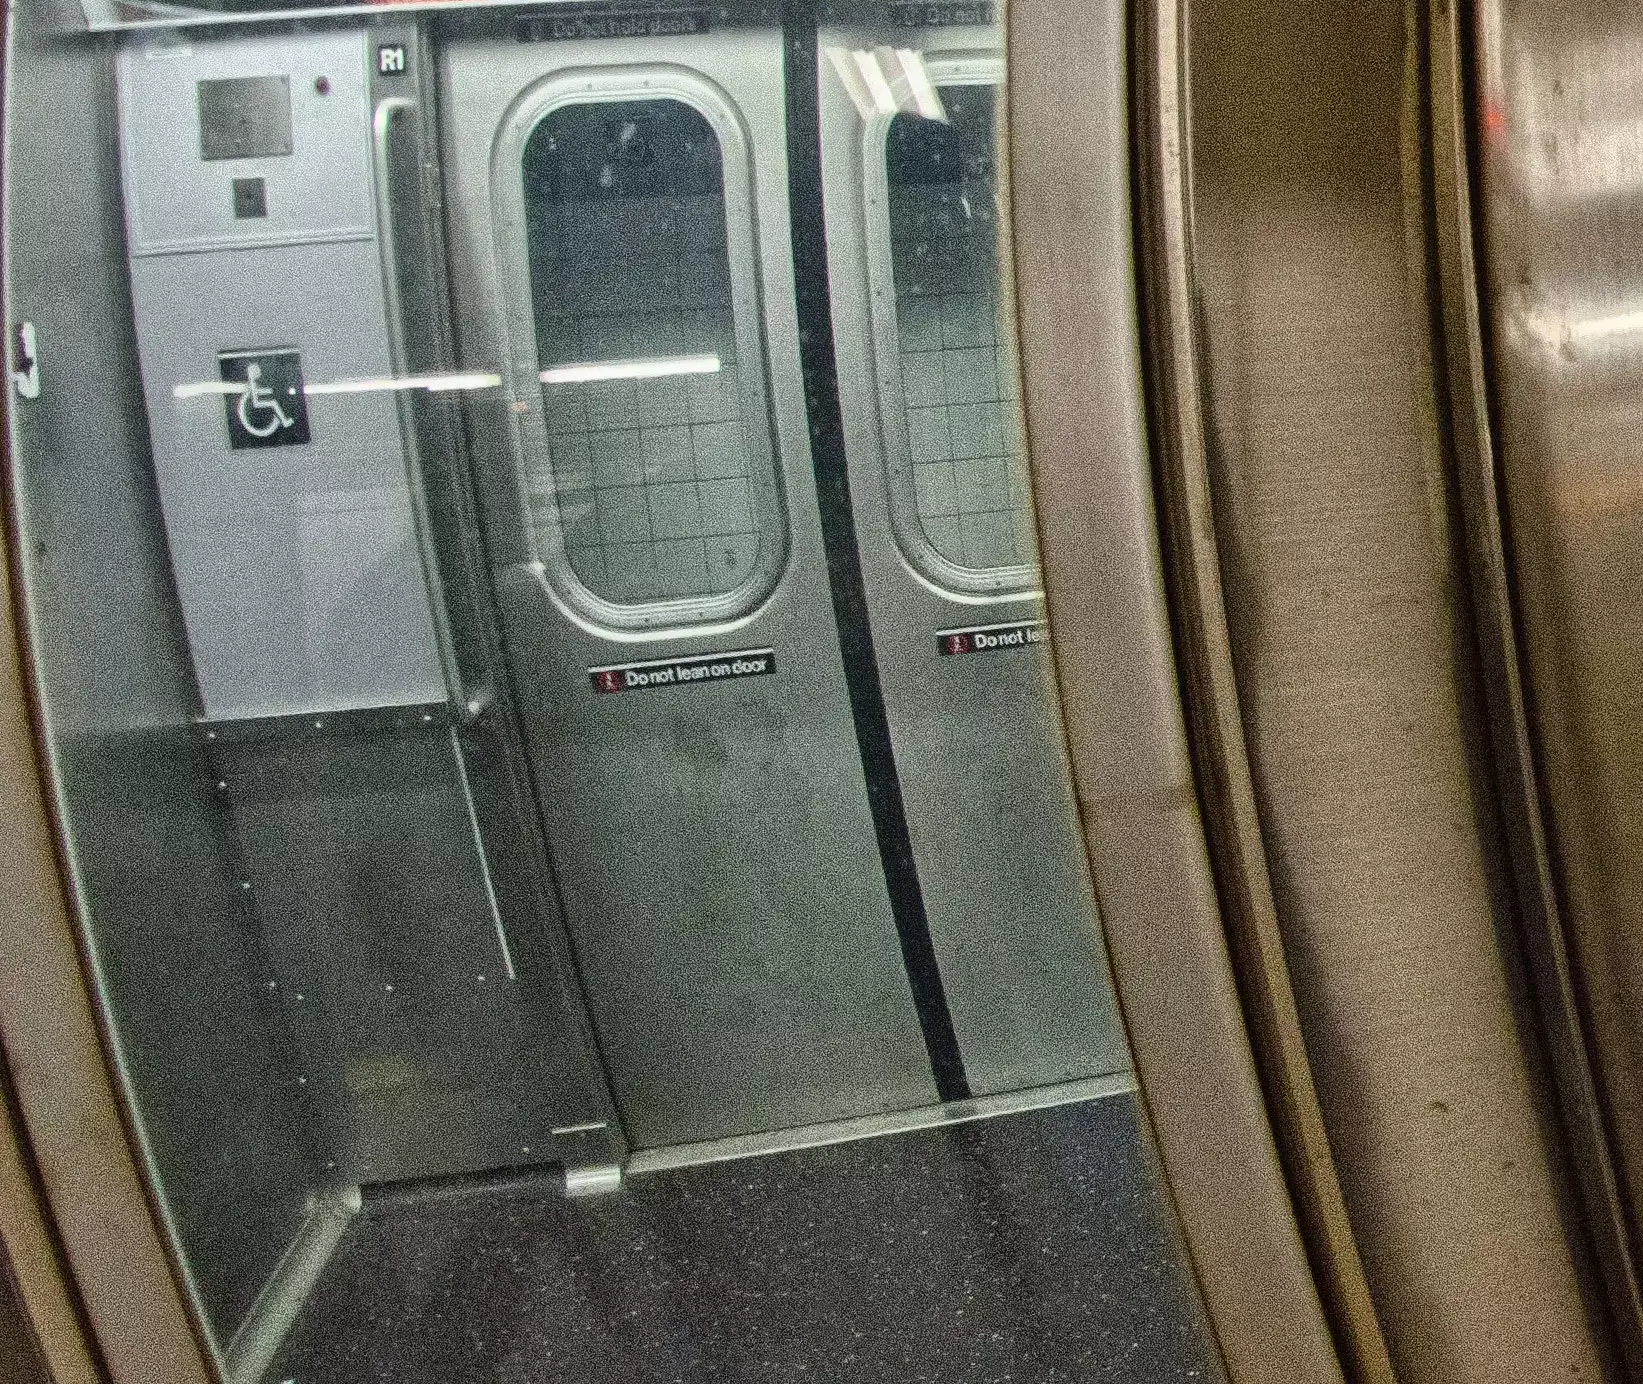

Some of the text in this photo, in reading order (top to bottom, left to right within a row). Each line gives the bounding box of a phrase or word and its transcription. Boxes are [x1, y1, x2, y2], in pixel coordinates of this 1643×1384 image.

[381, 48, 404, 72] R1
[974, 633, 997, 649] Do
[999, 629, 1024, 645] not
[625, 658, 767, 686] Do not lean on door
